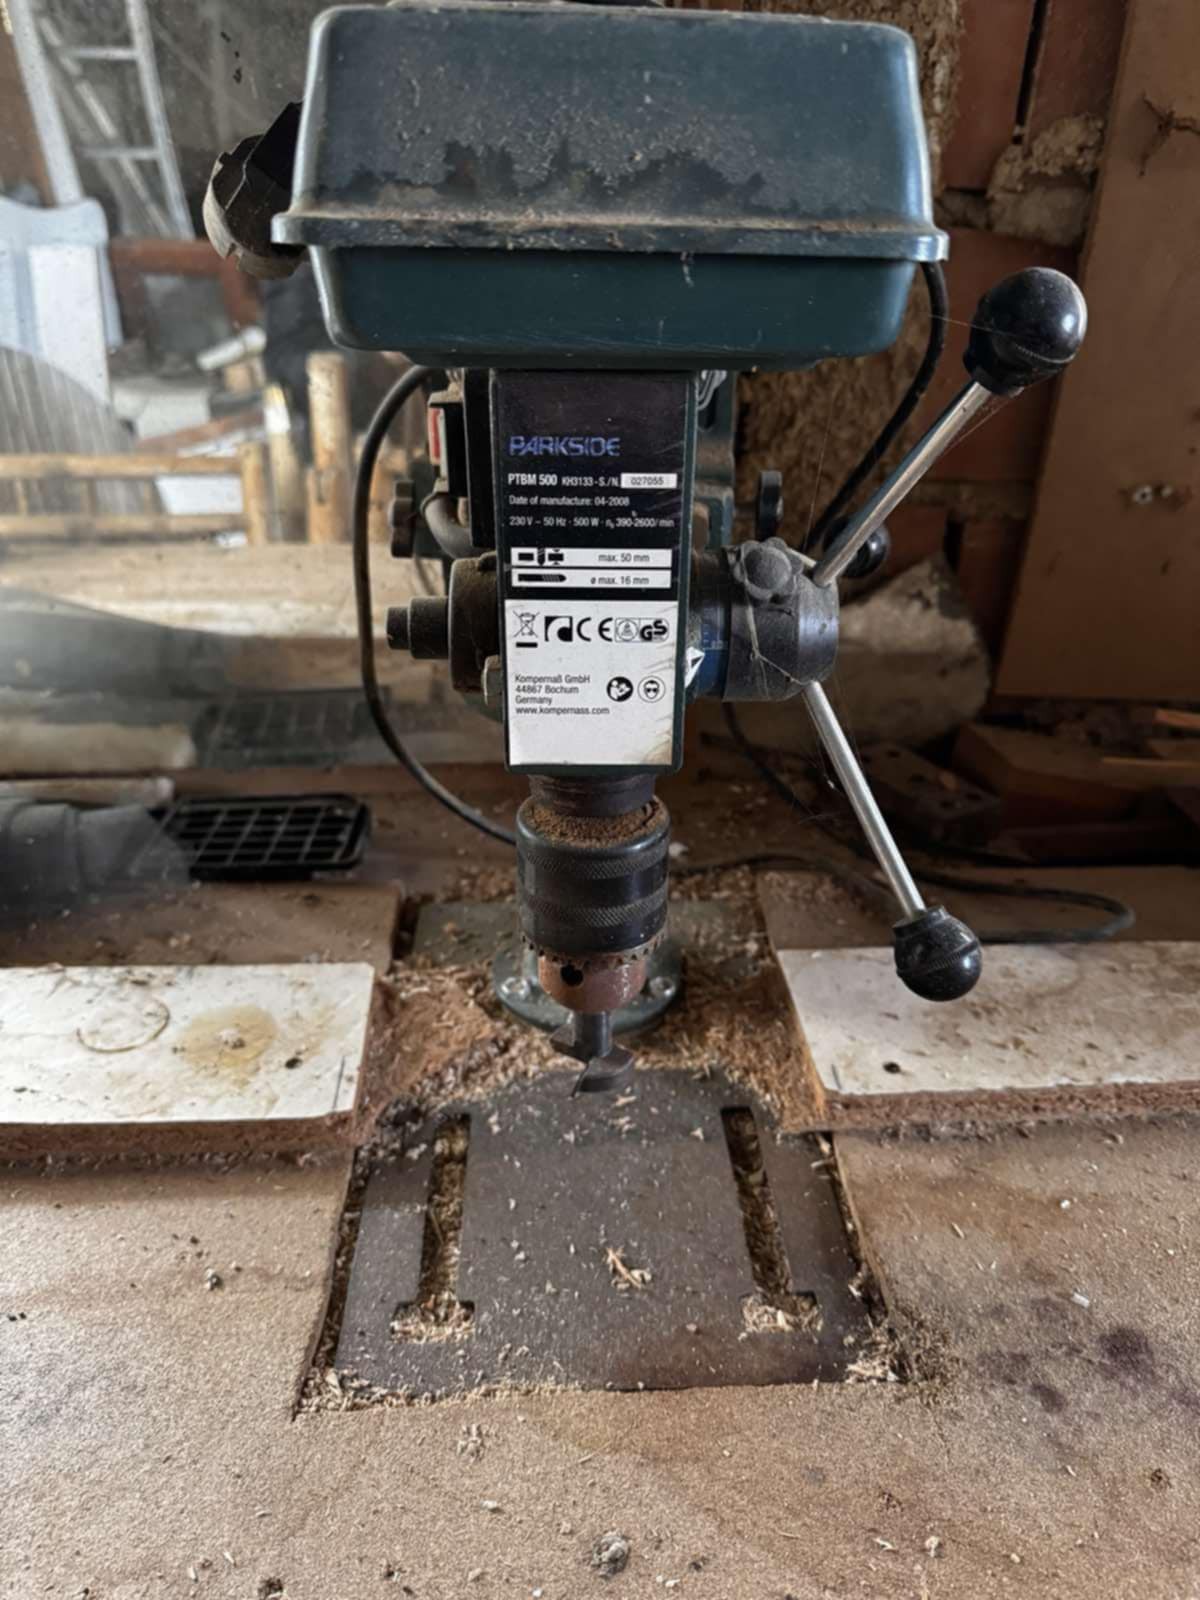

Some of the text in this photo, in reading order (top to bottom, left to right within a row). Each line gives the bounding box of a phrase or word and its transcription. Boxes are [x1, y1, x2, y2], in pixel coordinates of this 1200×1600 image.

[509, 436, 621, 457] PARKSIDE
[508, 473, 537, 485] PTBM
[539, 474, 558, 486] 500
[561, 476, 594, 487] KH3133
[630, 476, 665, 486] 027055
[509, 494, 529, 505] Date
[529, 495, 539, 505] of
[594, 496, 630, 506] 04-2008
[509, 516, 526, 526] 230
[526, 516, 534, 526] V
[543, 516, 555, 527] 50
[556, 517, 567, 527] Hz
[573, 517, 590, 527] 500
[591, 517, 600, 527] W
[598, 553, 650, 563] max. 50 mm
[598, 577, 618, 585] max.
[620, 576, 632, 585] 16
[632, 577, 650, 585] mm
[640, 620, 668, 641] GS
[515, 674, 590, 684] Kompernaß GmbH
[515, 684, 579, 694] 44867 Bochum
[515, 695, 553, 705] Germany
[515, 706, 610, 716] www.kompernass.com
